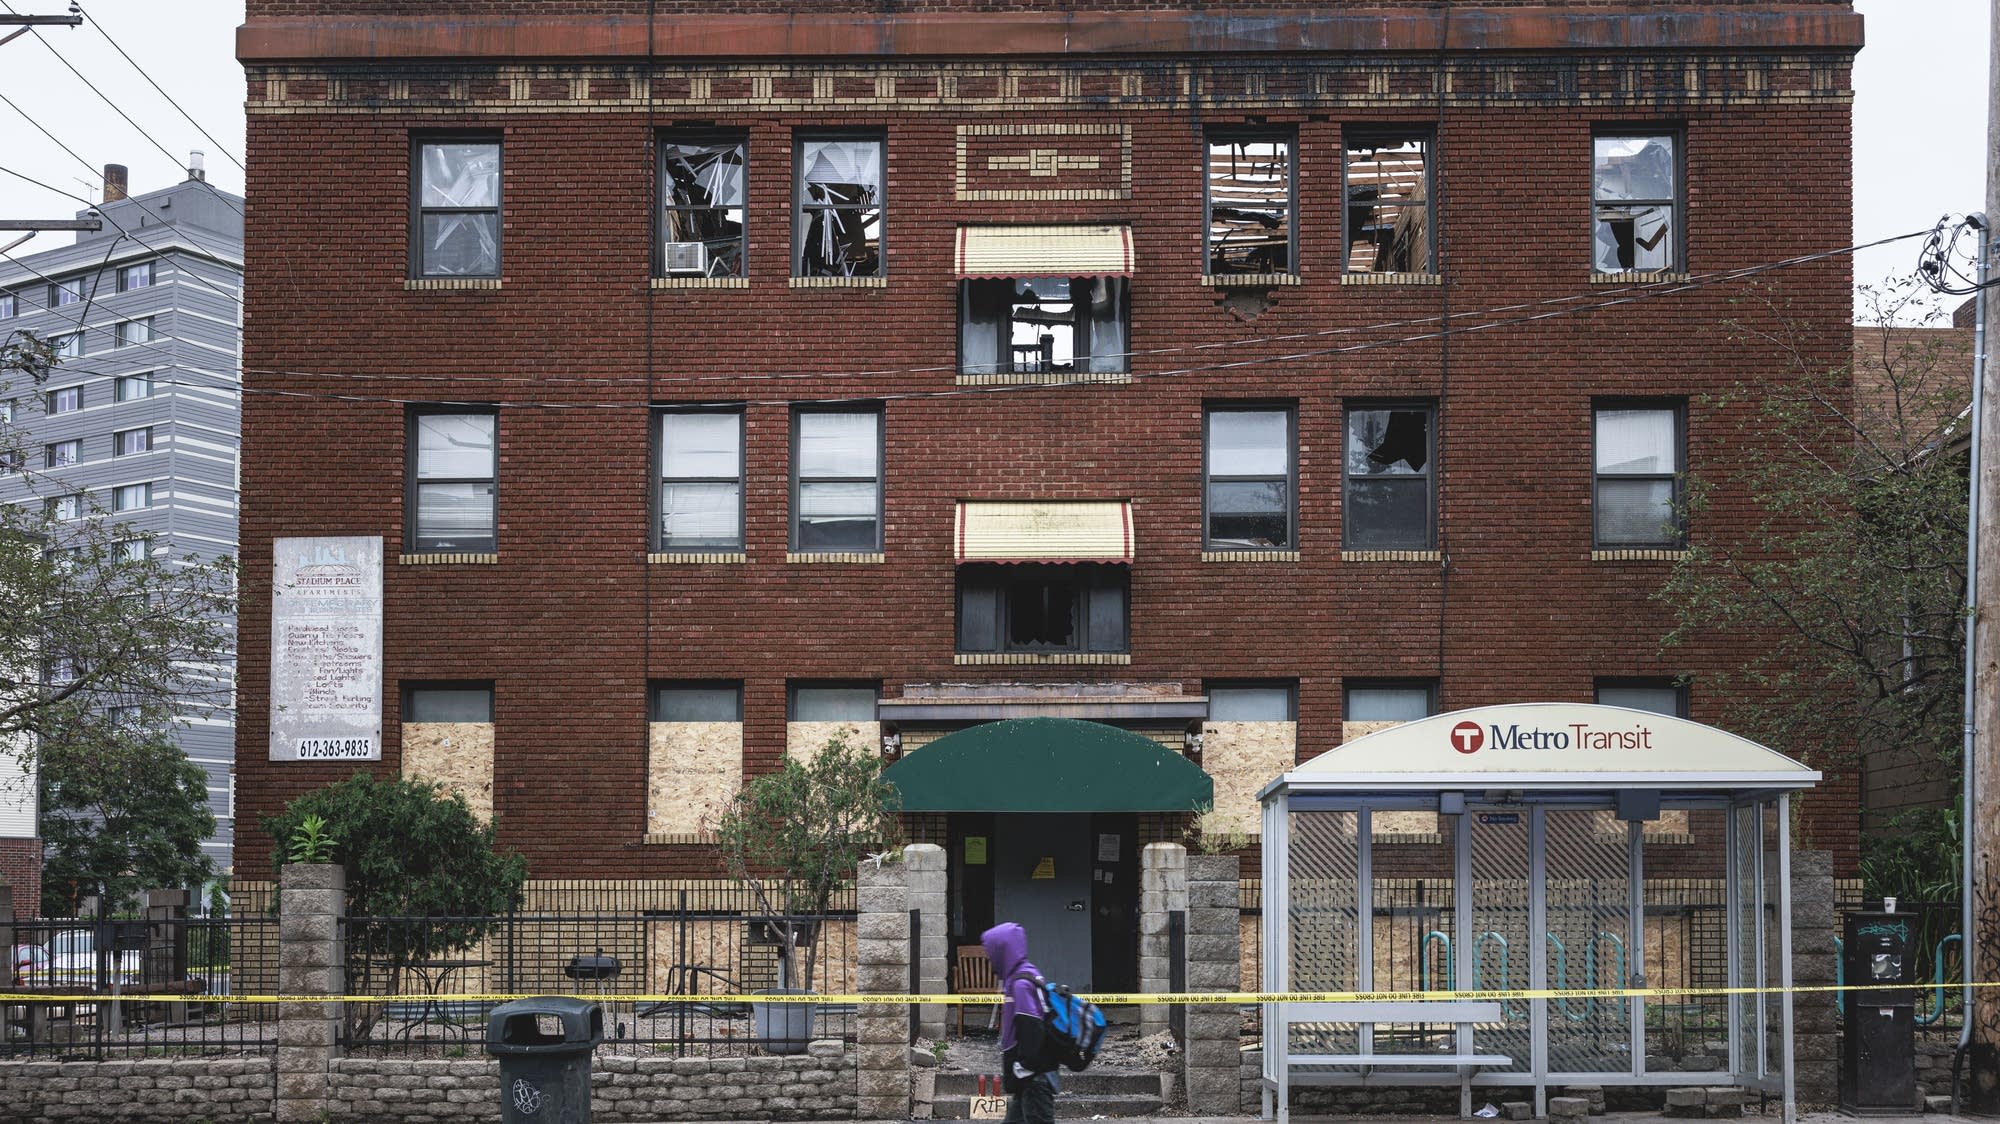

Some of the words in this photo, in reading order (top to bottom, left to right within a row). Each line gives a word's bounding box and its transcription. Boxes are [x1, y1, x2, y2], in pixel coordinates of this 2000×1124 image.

[296, 577, 333, 586] STADIUM
[335, 577, 361, 585] PLACE
[297, 588, 361, 596] APARTMENTS
[330, 674, 356, 683] Lights
[1489, 724, 1569, 750] Metro
[1568, 724, 1652, 750] Transit
[300, 740, 369, 757] 612-363-9835
[973, 1098, 1006, 1114] RIP
